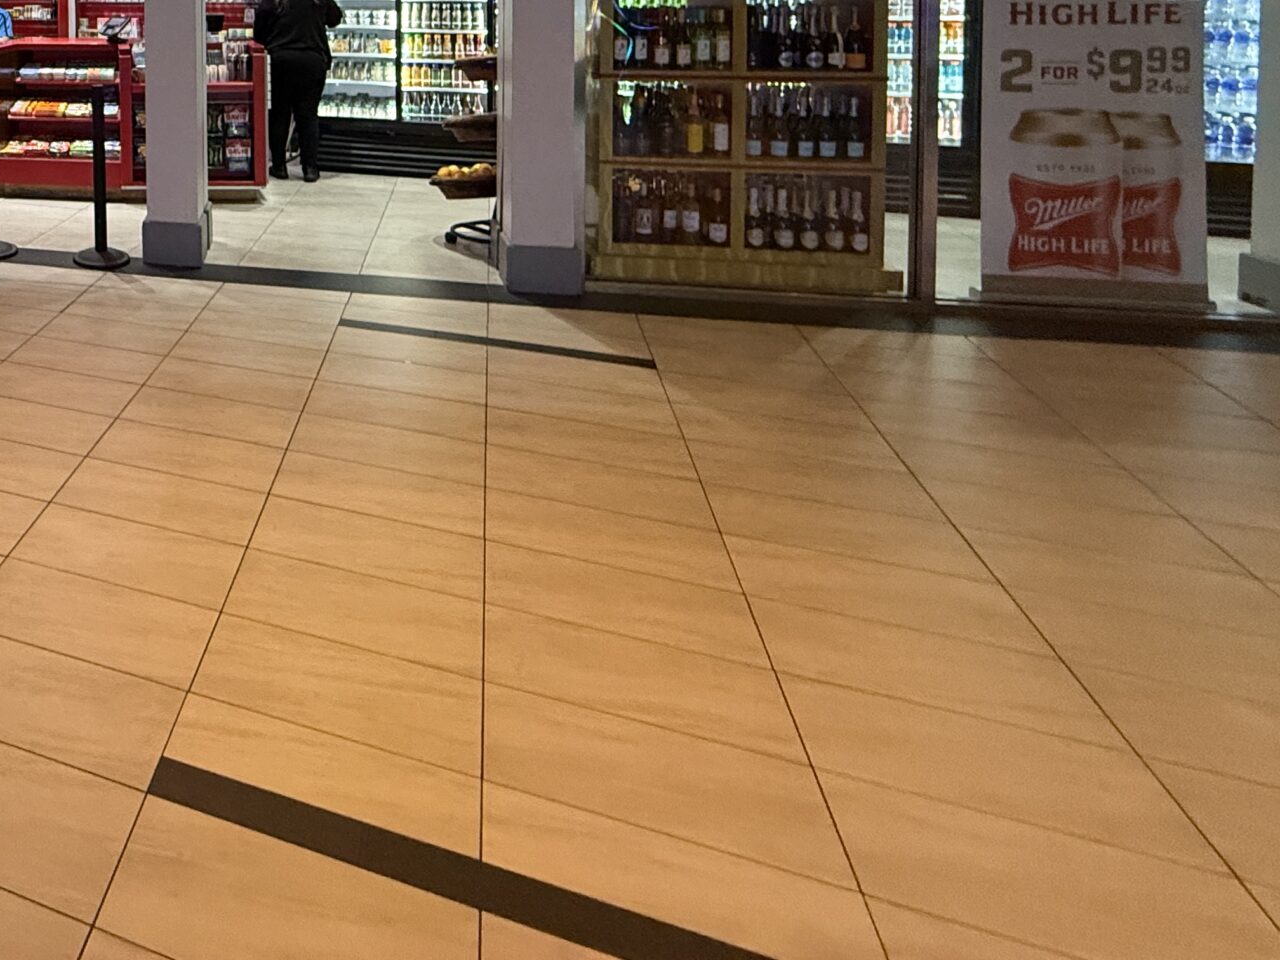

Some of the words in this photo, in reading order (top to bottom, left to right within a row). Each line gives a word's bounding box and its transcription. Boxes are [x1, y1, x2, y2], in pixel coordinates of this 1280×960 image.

[1009, 1, 1098, 25] HIGH
[1107, 0, 1183, 25] LIFE
[1000, 48, 1033, 93] 2
[1041, 65, 1078, 80] FOR
[1024, 196, 1105, 230] Miller
[1122, 199, 1164, 224] iller
[1018, 236, 1064, 252] HIGH
[1071, 238, 1110, 255] LIFE
[1132, 237, 1171, 253] LIFE
